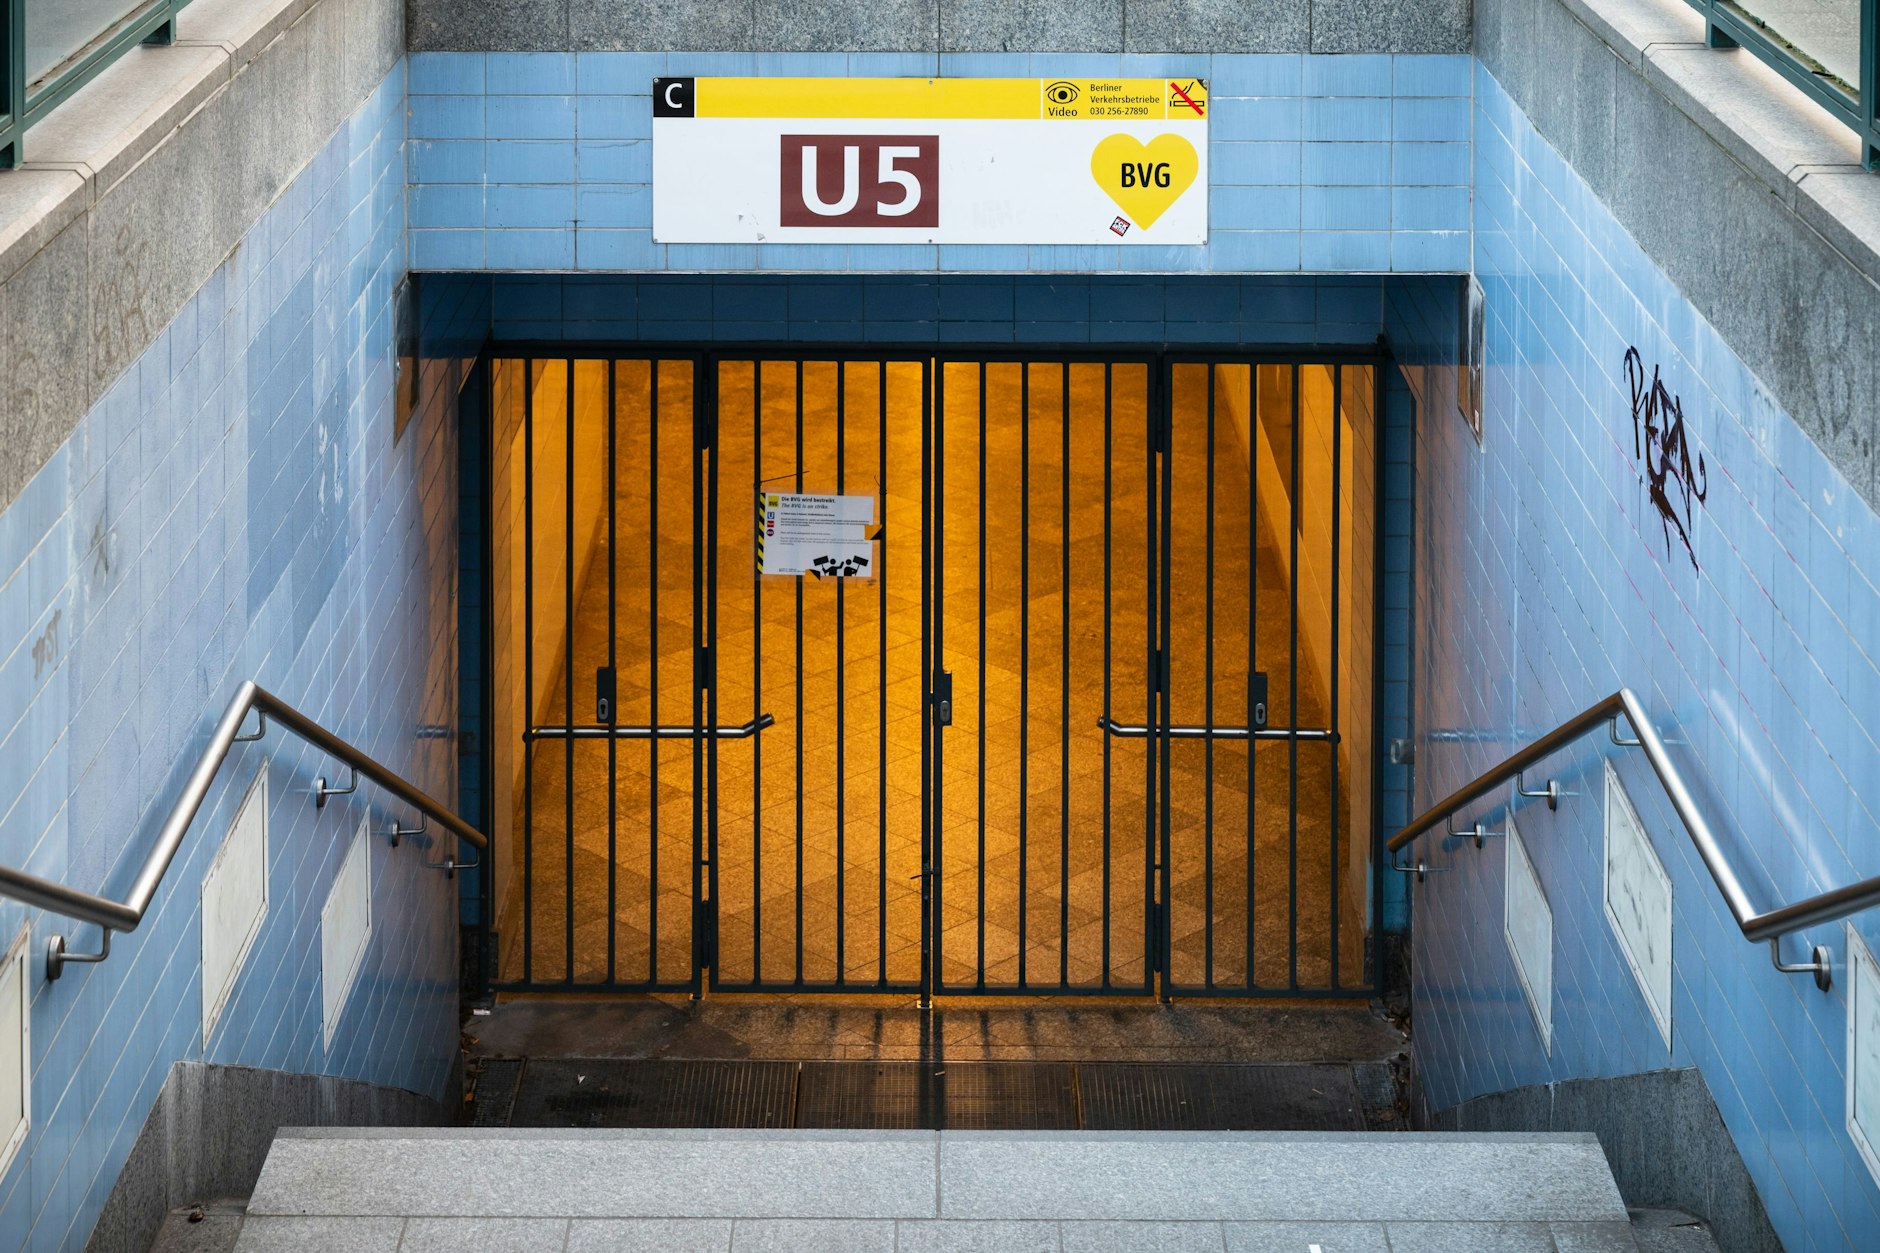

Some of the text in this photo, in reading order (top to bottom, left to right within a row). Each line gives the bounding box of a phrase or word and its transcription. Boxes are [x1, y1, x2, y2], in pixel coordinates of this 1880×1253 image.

[1090, 83, 1122, 92] Berliner
[665, 82, 683, 109] C
[1090, 95, 1160, 104] Verkehrsbetriebe
[1048, 107, 1078, 117] Video
[1090, 107, 1149, 116] 030 256-27890
[1121, 162, 1170, 188] BVG
